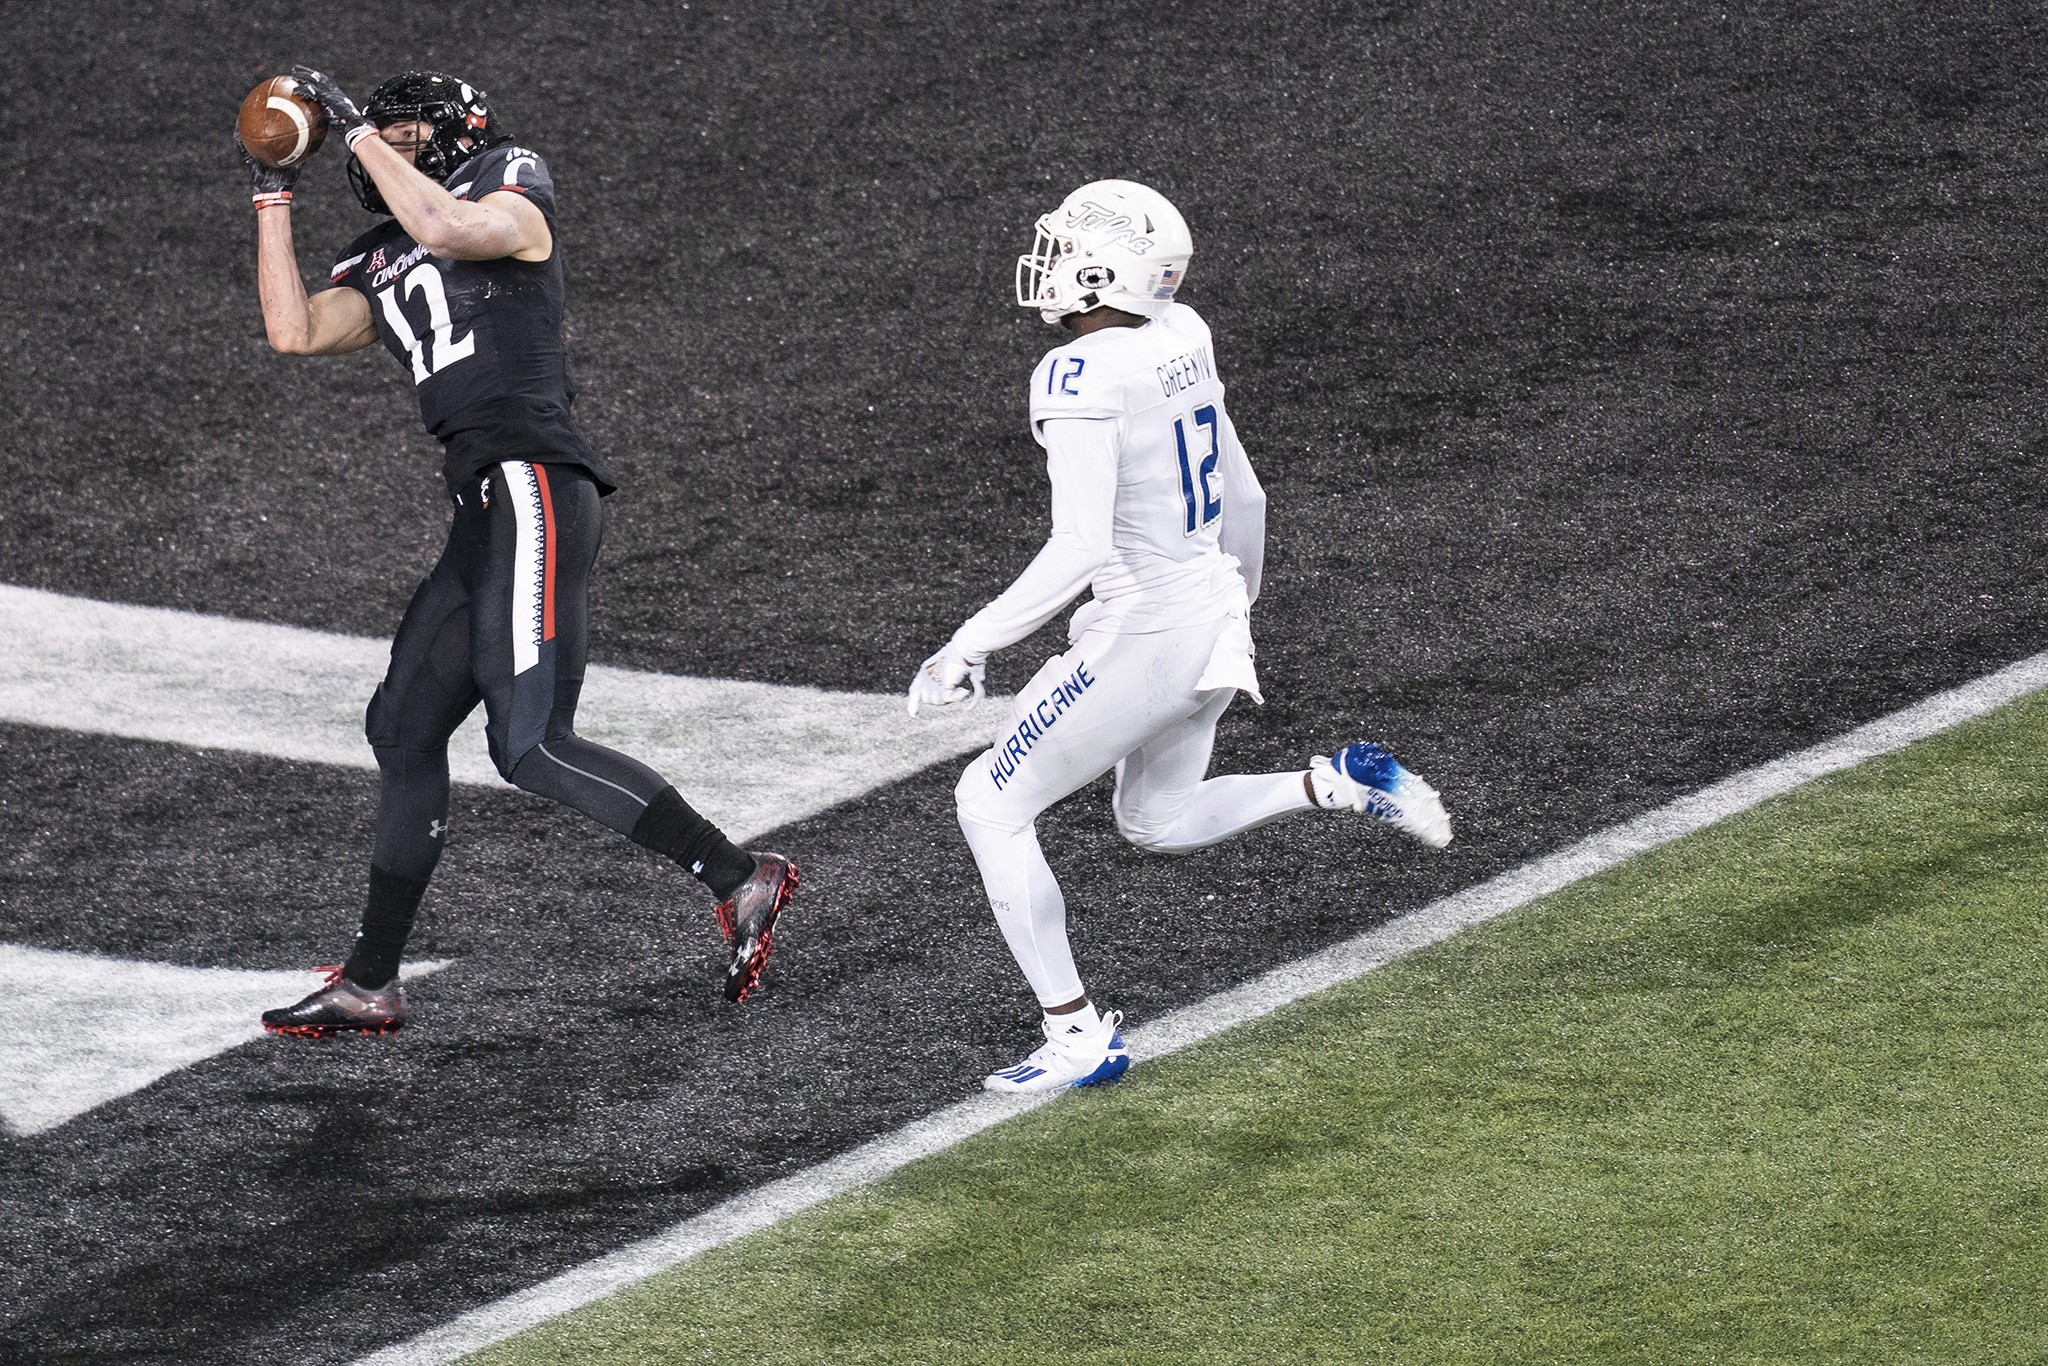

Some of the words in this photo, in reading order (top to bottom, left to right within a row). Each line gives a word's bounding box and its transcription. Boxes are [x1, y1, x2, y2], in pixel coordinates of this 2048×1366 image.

[371, 243, 431, 288] CINCINNA
[1066, 201, 1155, 256] Tulsa
[376, 263, 475, 386] 12
[1047, 357, 1086, 396] 12
[1171, 400, 1222, 538] 12
[990, 660, 1096, 791] HURRICANE
